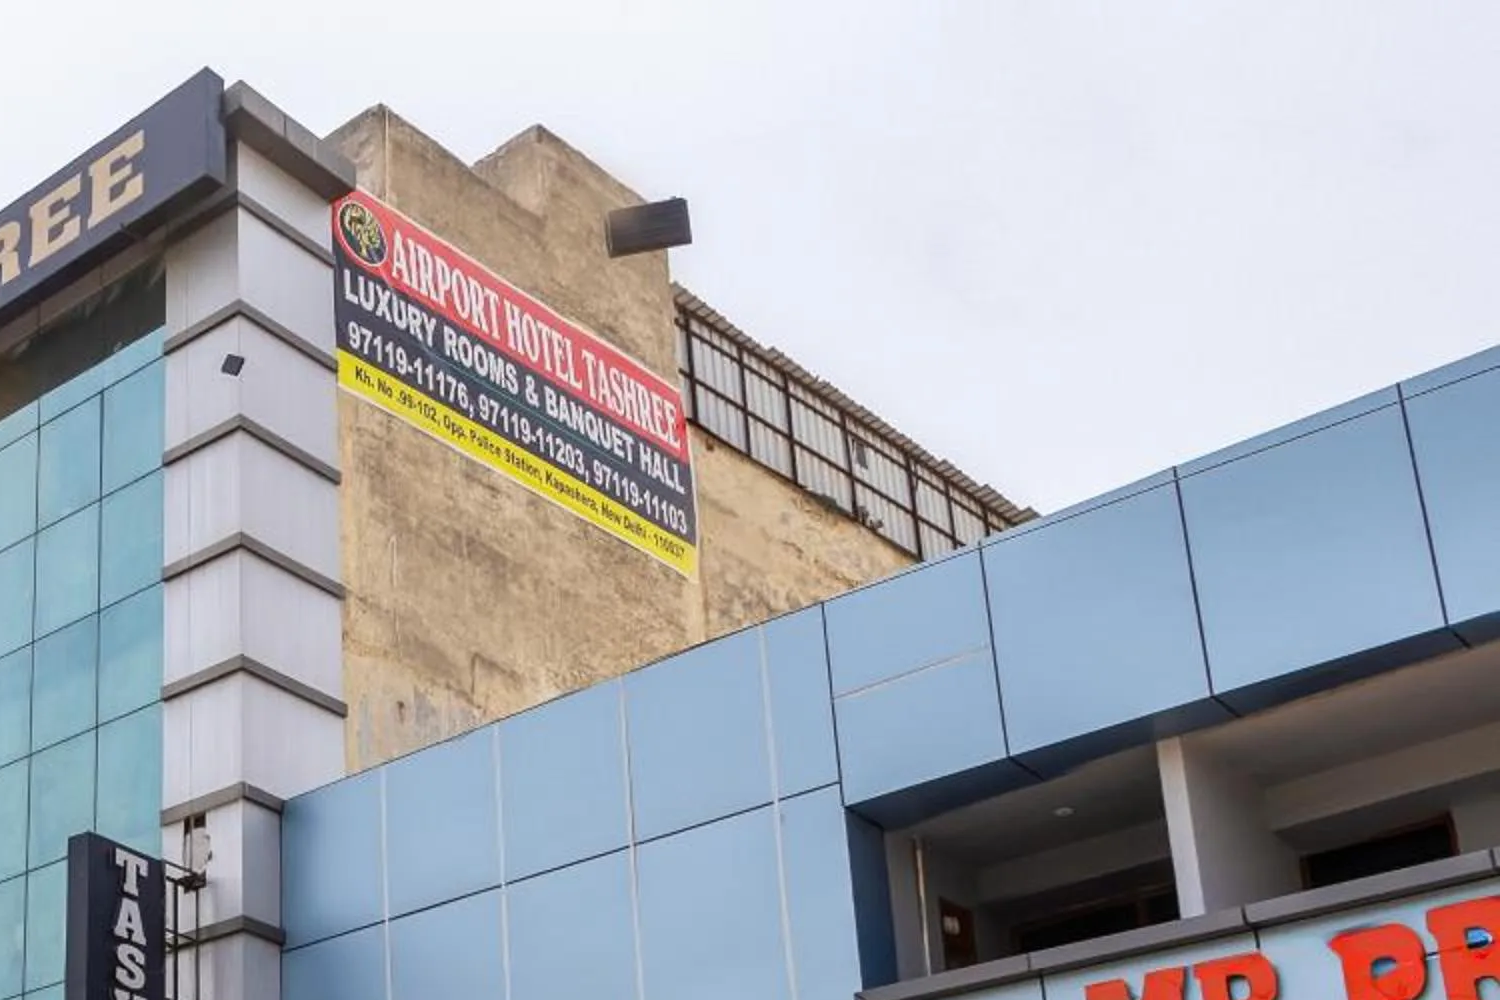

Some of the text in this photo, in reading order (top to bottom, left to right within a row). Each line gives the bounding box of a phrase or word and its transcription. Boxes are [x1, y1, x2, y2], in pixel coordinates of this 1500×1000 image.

[343, 269, 686, 495] LUXURY ROOMS & BANQUET HALL
[347, 320, 688, 535] 97119-11176, 97119-11203, 97119-11103
[392, 230, 681, 450] AIRPORT HOTEL TASHREE
[469, 428, 501, 457] Police
[600, 501, 621, 526] New
